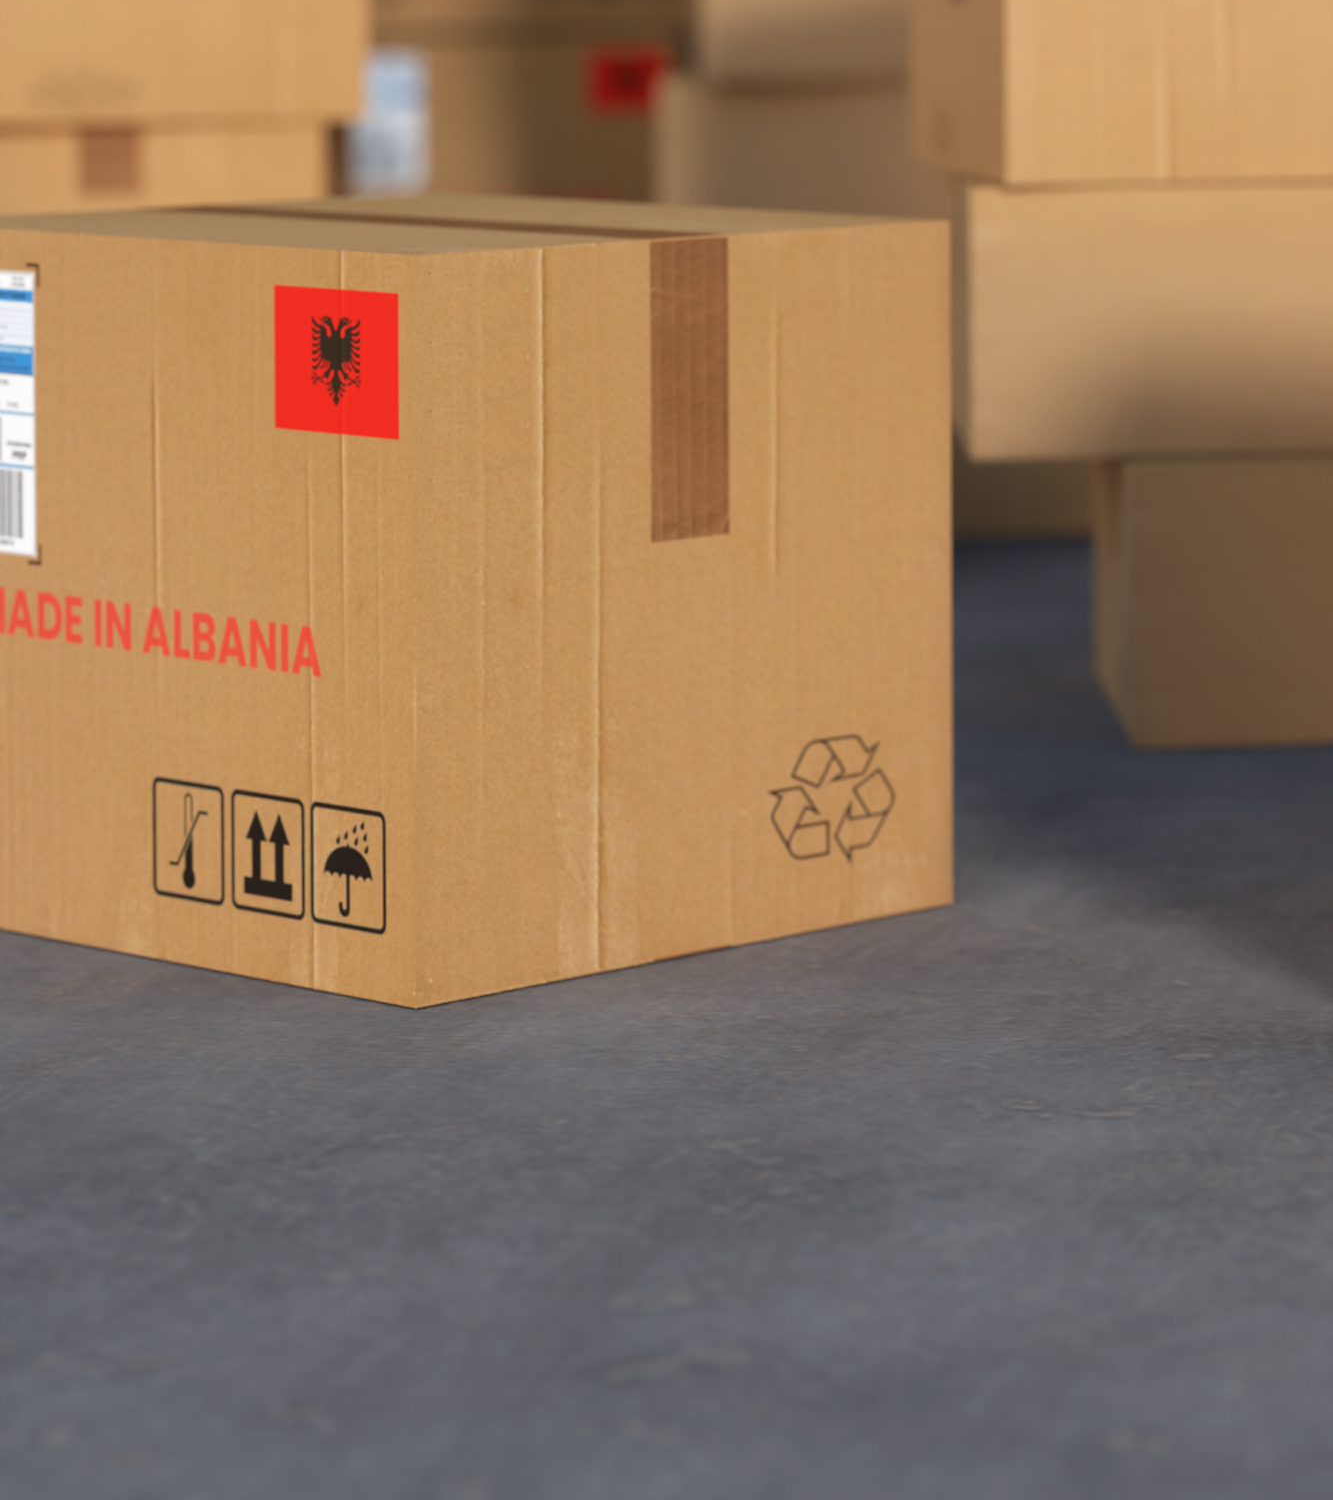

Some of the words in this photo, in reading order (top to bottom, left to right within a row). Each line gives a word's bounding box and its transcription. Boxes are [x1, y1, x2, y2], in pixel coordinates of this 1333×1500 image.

[0, 587, 83, 644] ADE
[94, 599, 132, 652] IN
[143, 606, 321, 678] ALBANIA
